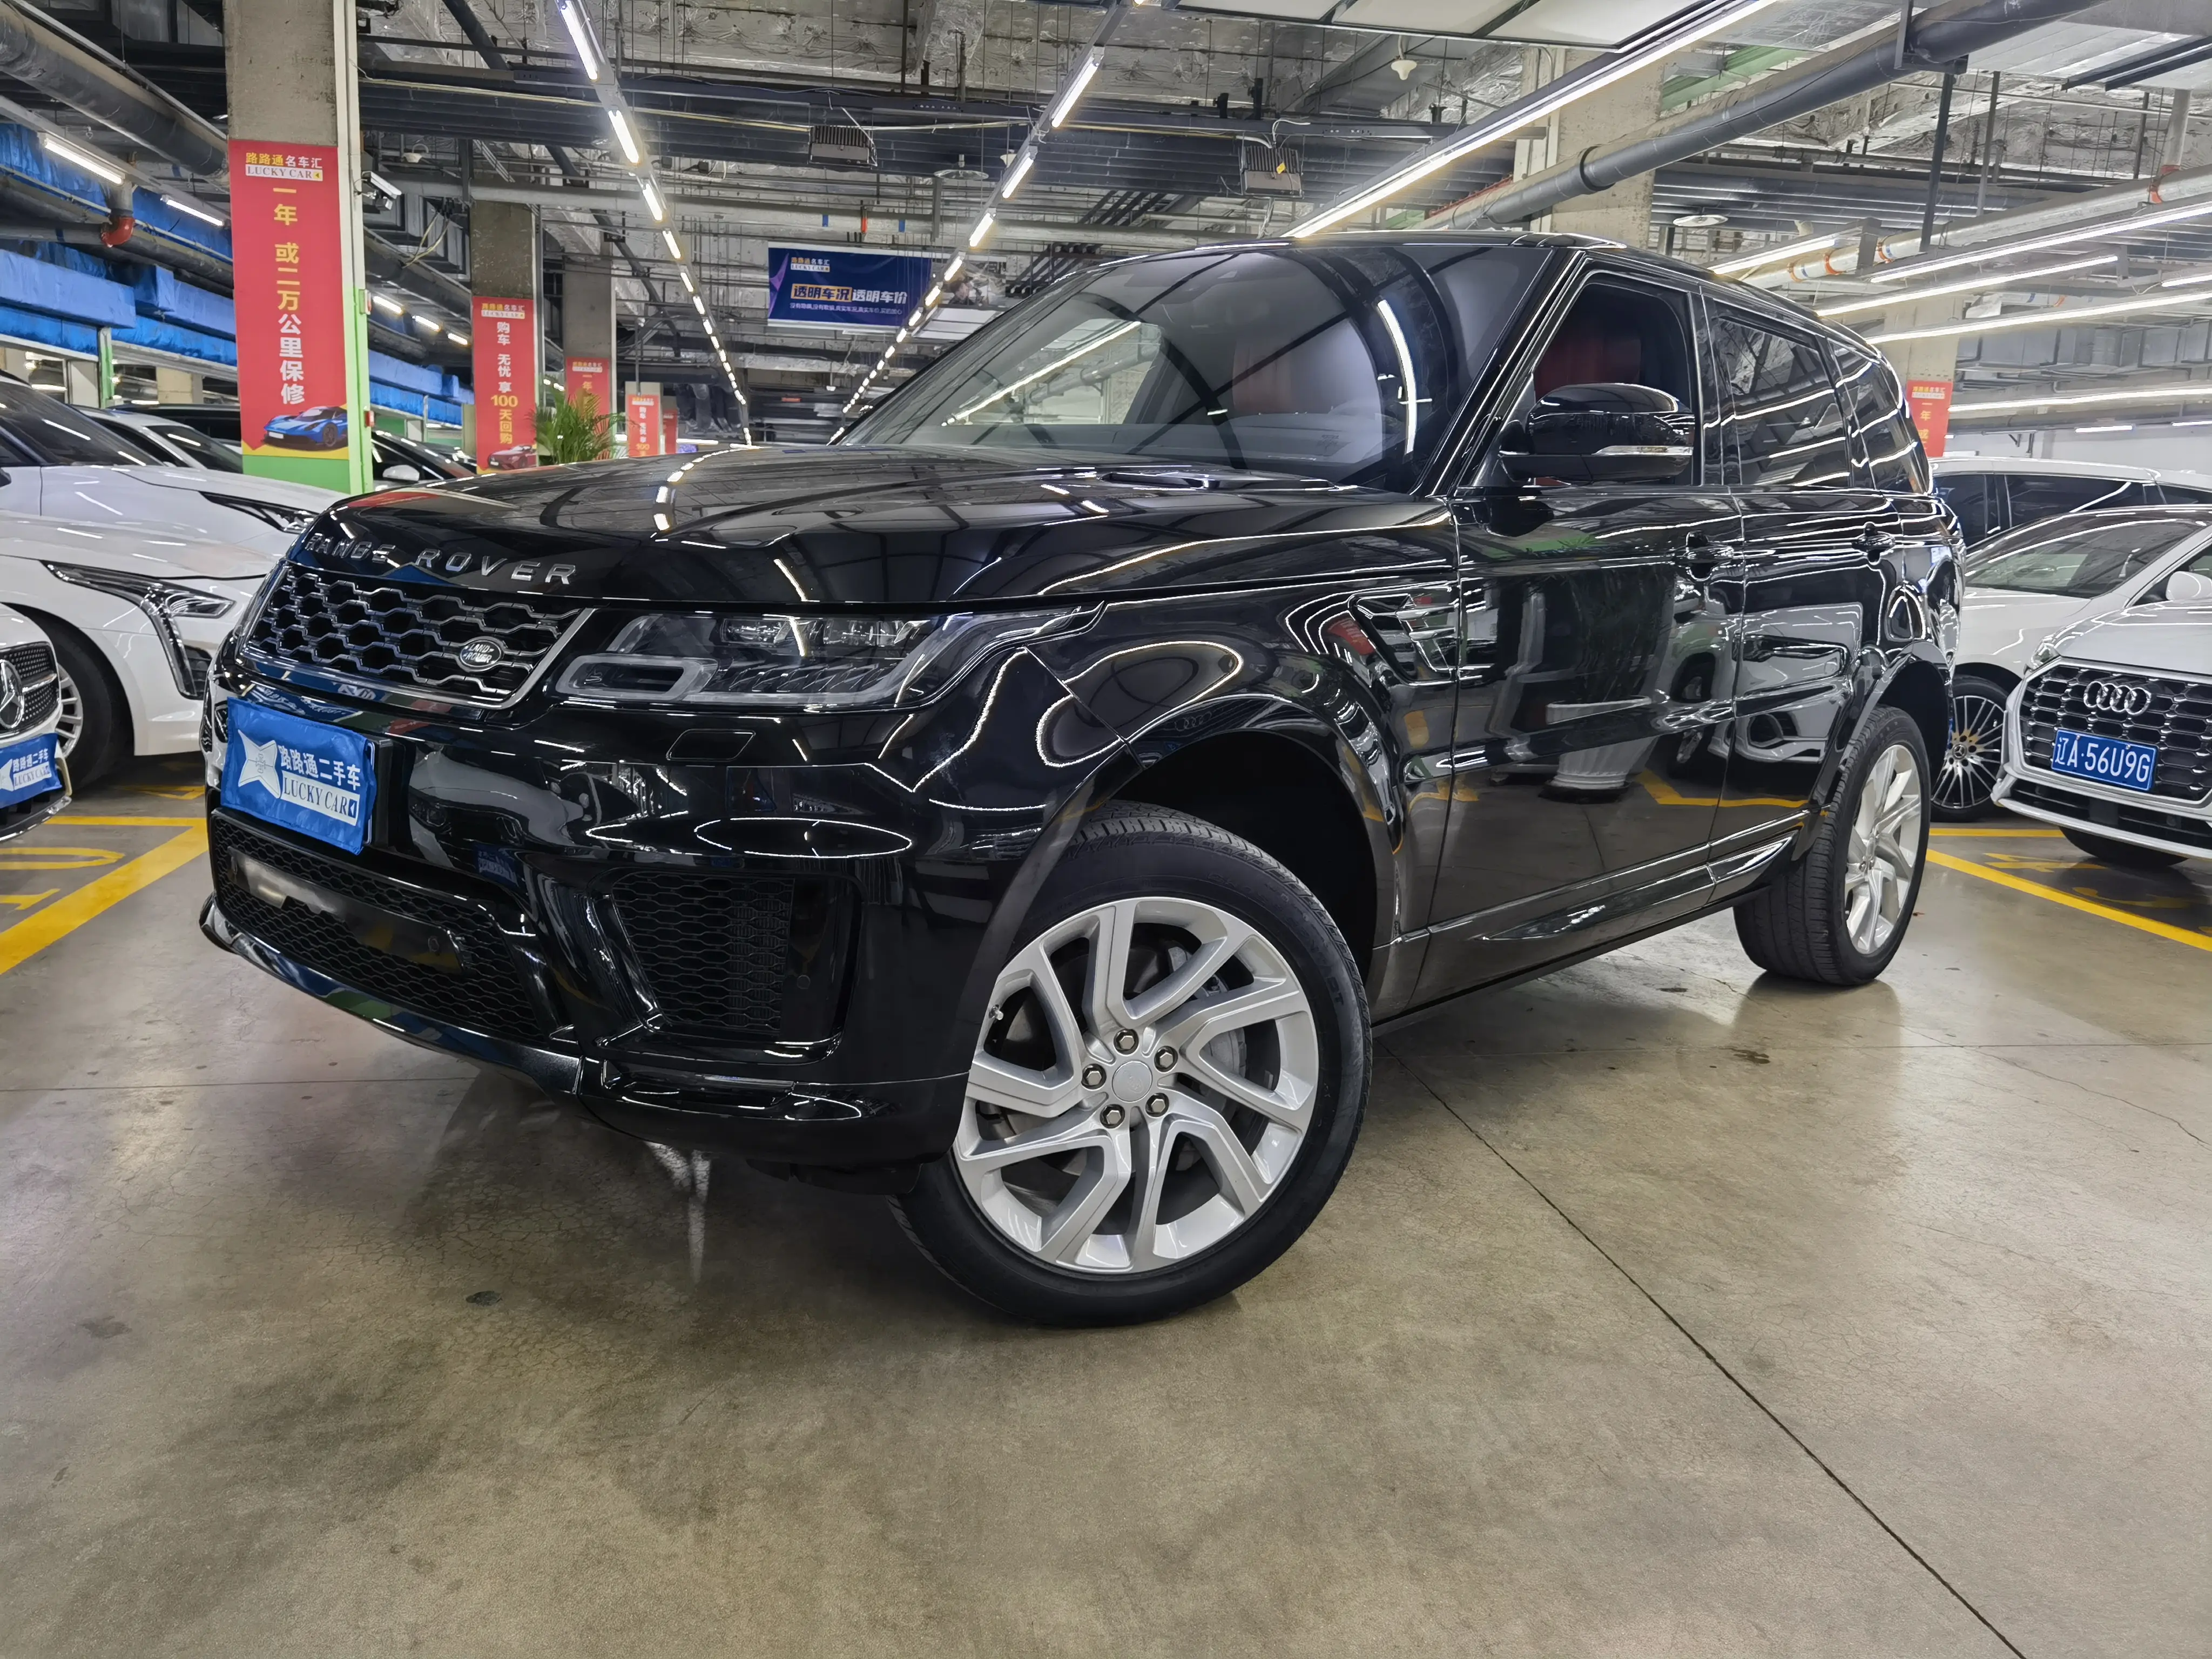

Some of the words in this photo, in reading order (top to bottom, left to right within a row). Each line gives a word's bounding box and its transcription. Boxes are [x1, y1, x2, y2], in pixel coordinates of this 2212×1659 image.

[246, 152, 322, 169] 路路通名车汇
[248, 166, 286, 177] LUCKY
[289, 169, 312, 179] CAR
[305, 532, 397, 563] RANGE
[415, 548, 577, 585] ROVER
[468, 643, 490, 653] LAND
[465, 652, 493, 663] ROVER
[278, 745, 361, 791] 路路通二手车
[284, 777, 323, 806] LUCKY
[325, 791, 348, 816] CAR
